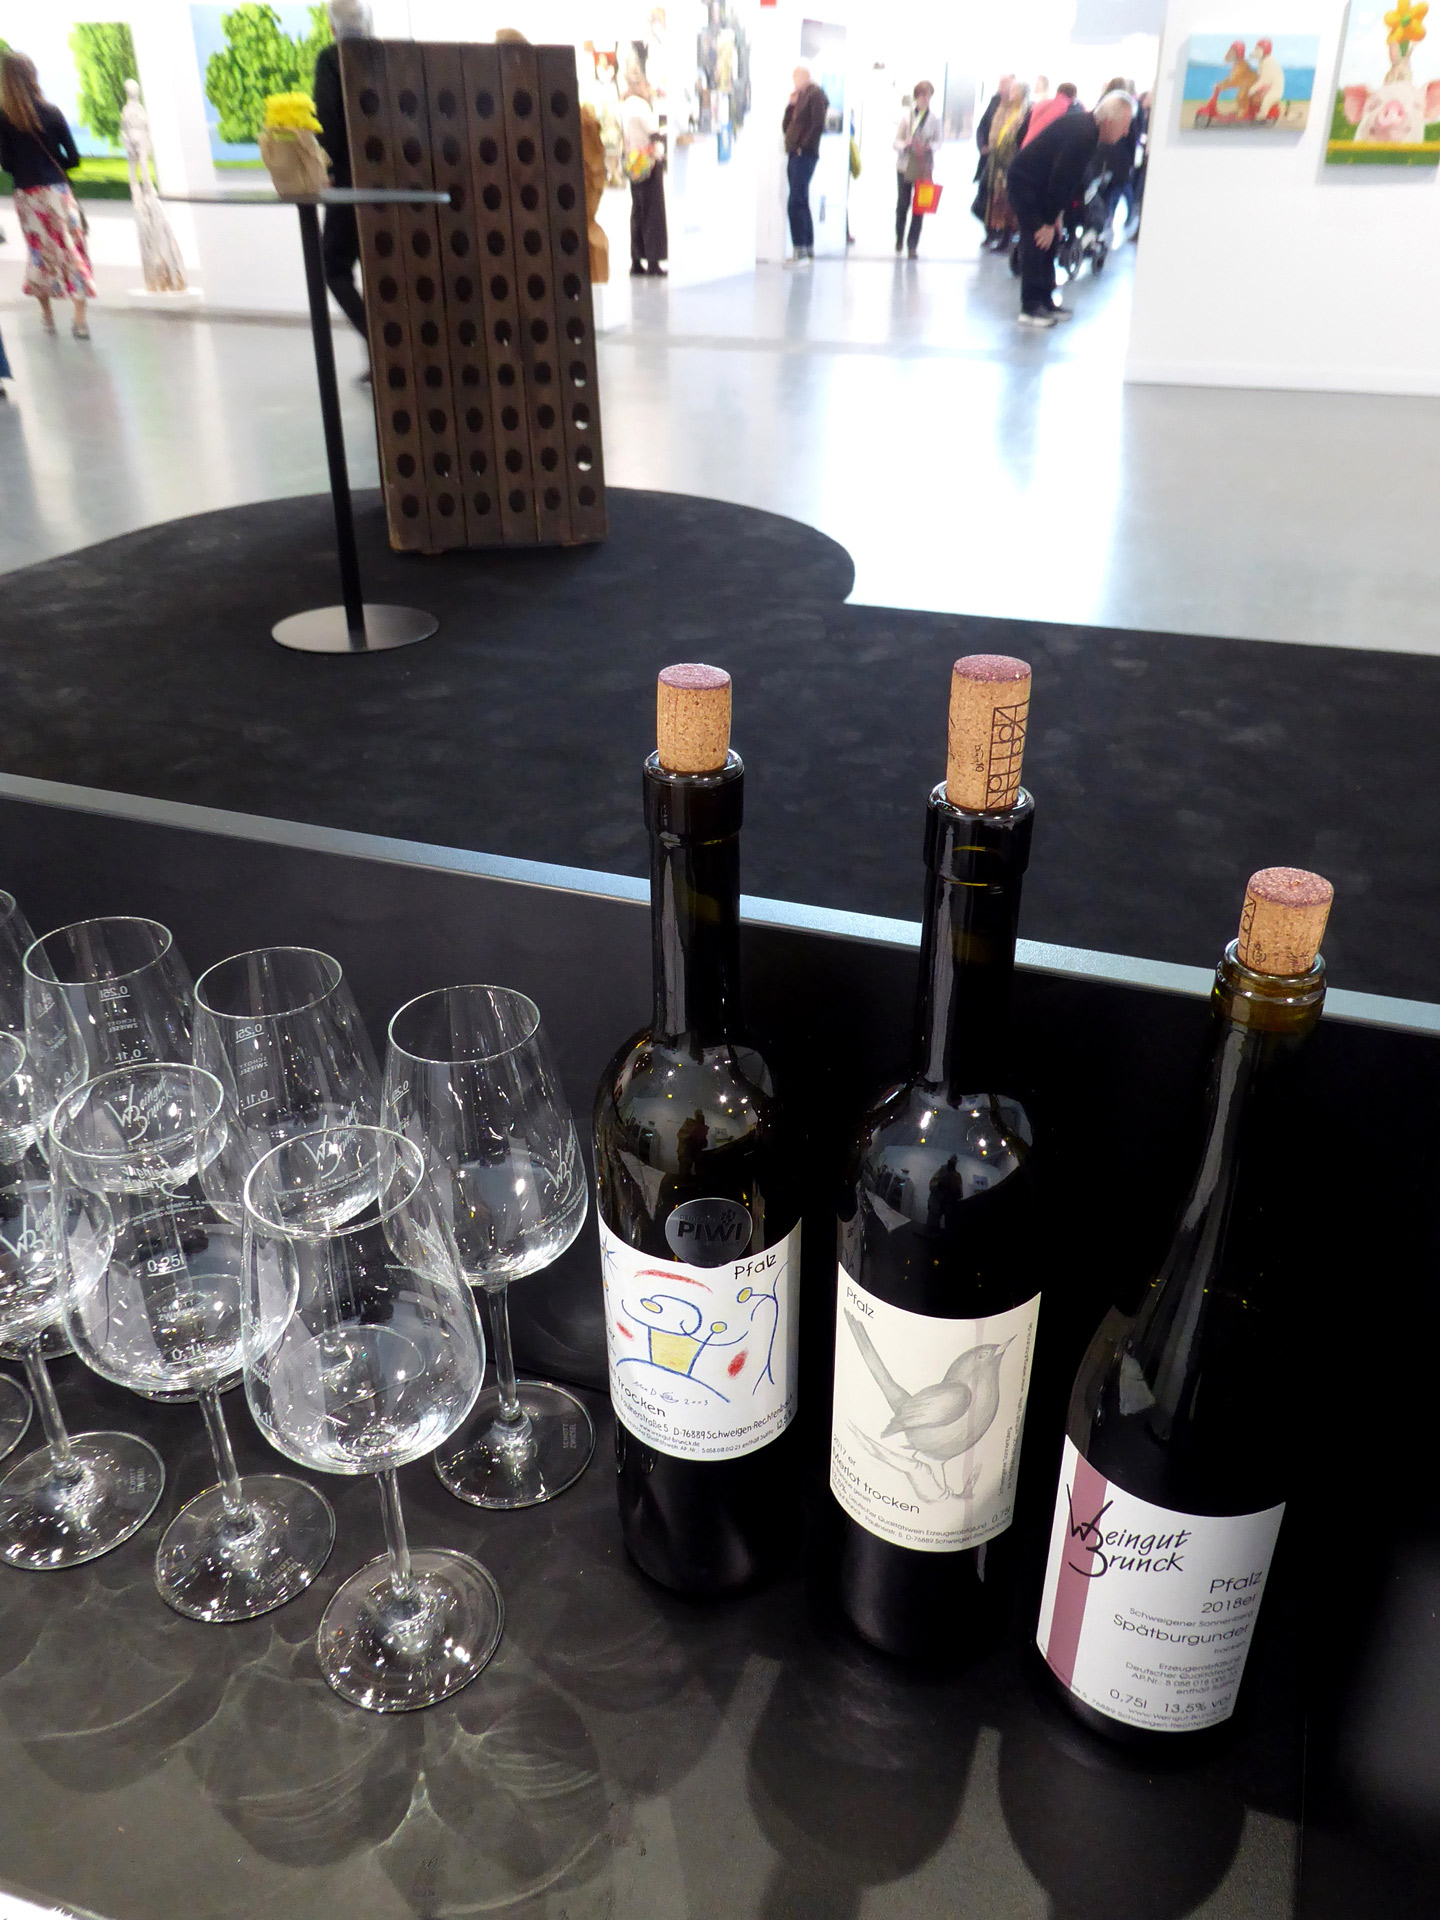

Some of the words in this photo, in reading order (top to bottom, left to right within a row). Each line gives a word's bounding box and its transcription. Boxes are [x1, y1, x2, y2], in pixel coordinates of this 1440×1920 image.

[677, 1220, 743, 1242] PIWI
[734, 1253, 777, 1281] Pfalz
[846, 1285, 875, 1320] Pfalz
[863, 1482, 920, 1515] trocken
[1066, 1483, 1193, 1556] Weingut
[1068, 1521, 1185, 1578] Brunck
[1209, 1571, 1263, 1594] Pfalz
[1113, 1613, 1250, 1647] Spätburgunder
